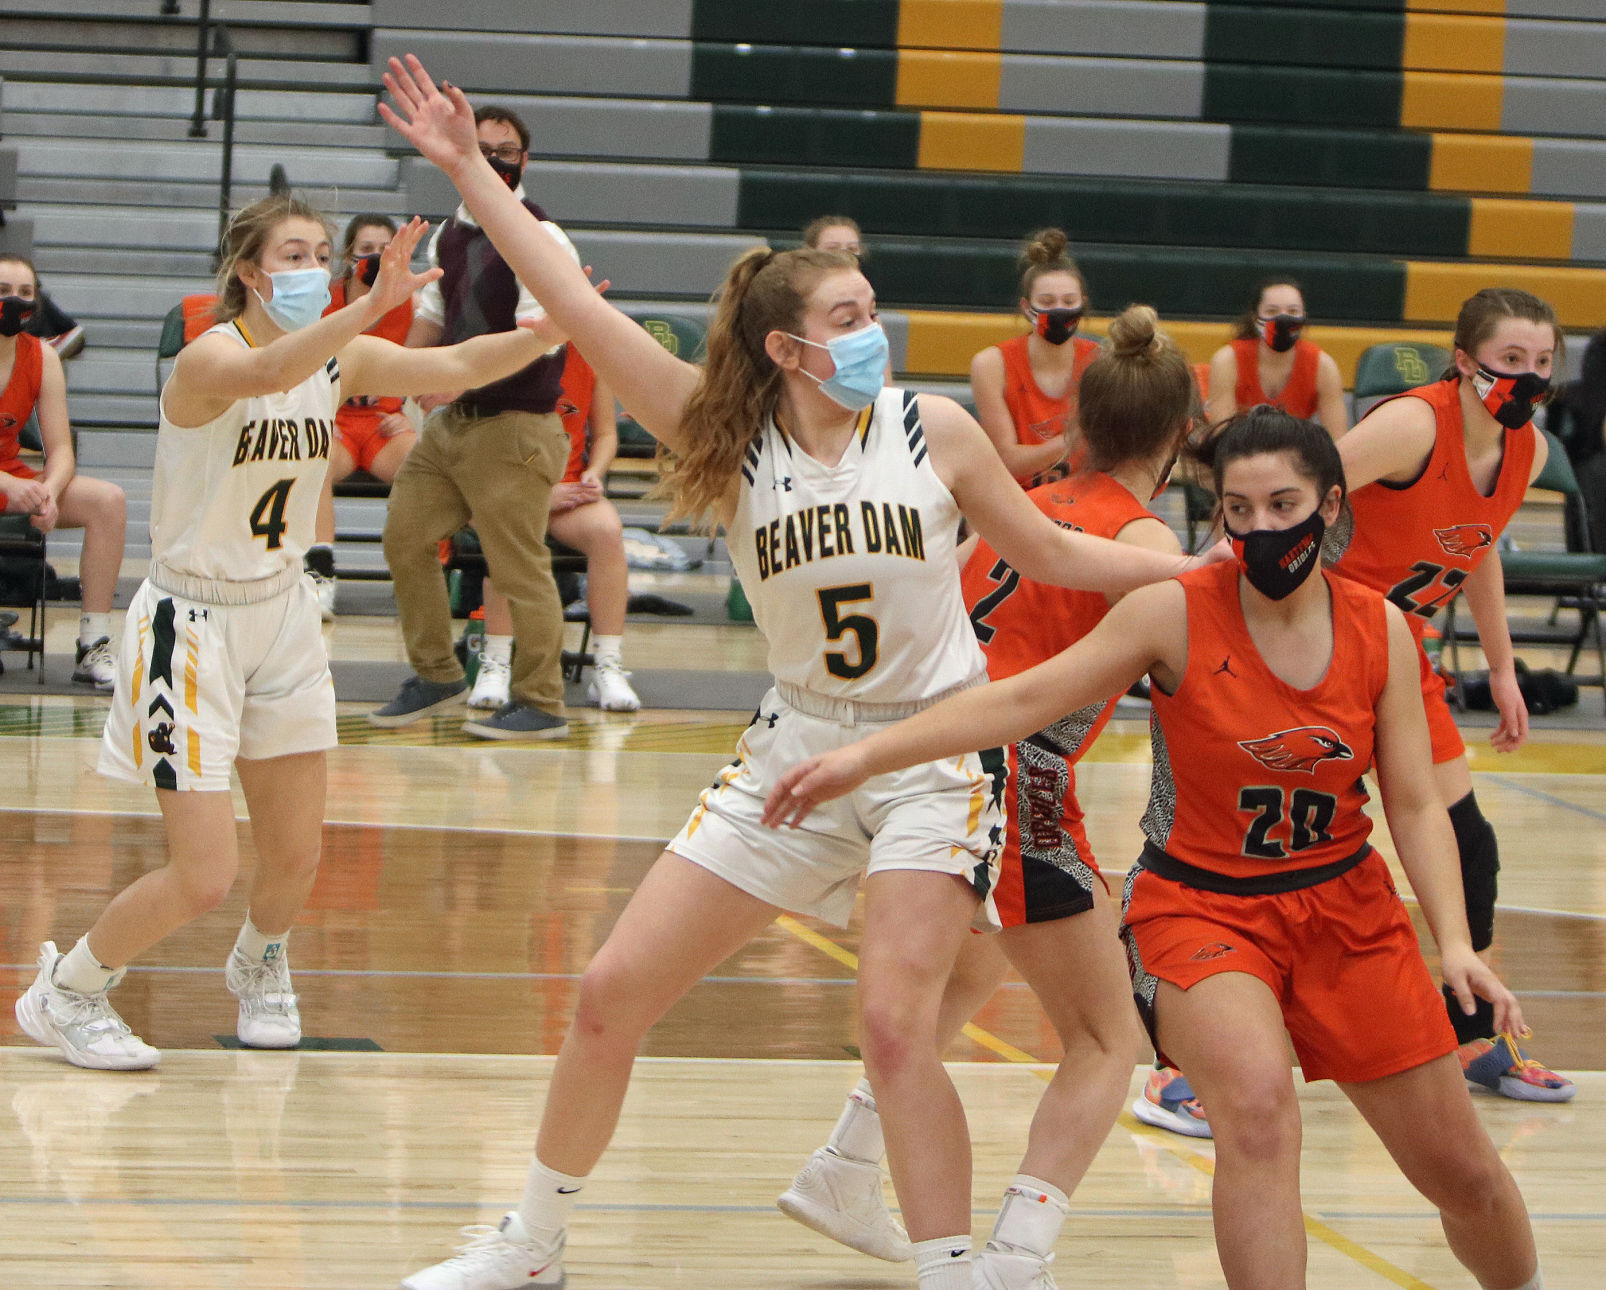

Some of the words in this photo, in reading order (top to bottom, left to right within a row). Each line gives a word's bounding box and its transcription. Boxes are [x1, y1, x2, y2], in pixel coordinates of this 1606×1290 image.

[232, 417, 302, 468] BEAVER
[304, 417, 334, 460] DA
[249, 477, 299, 552] 4
[755, 502, 856, 582] BEAVER
[860, 500, 927, 562] DAM
[814, 581, 881, 681] 5
[1237, 784, 1339, 859] 20
